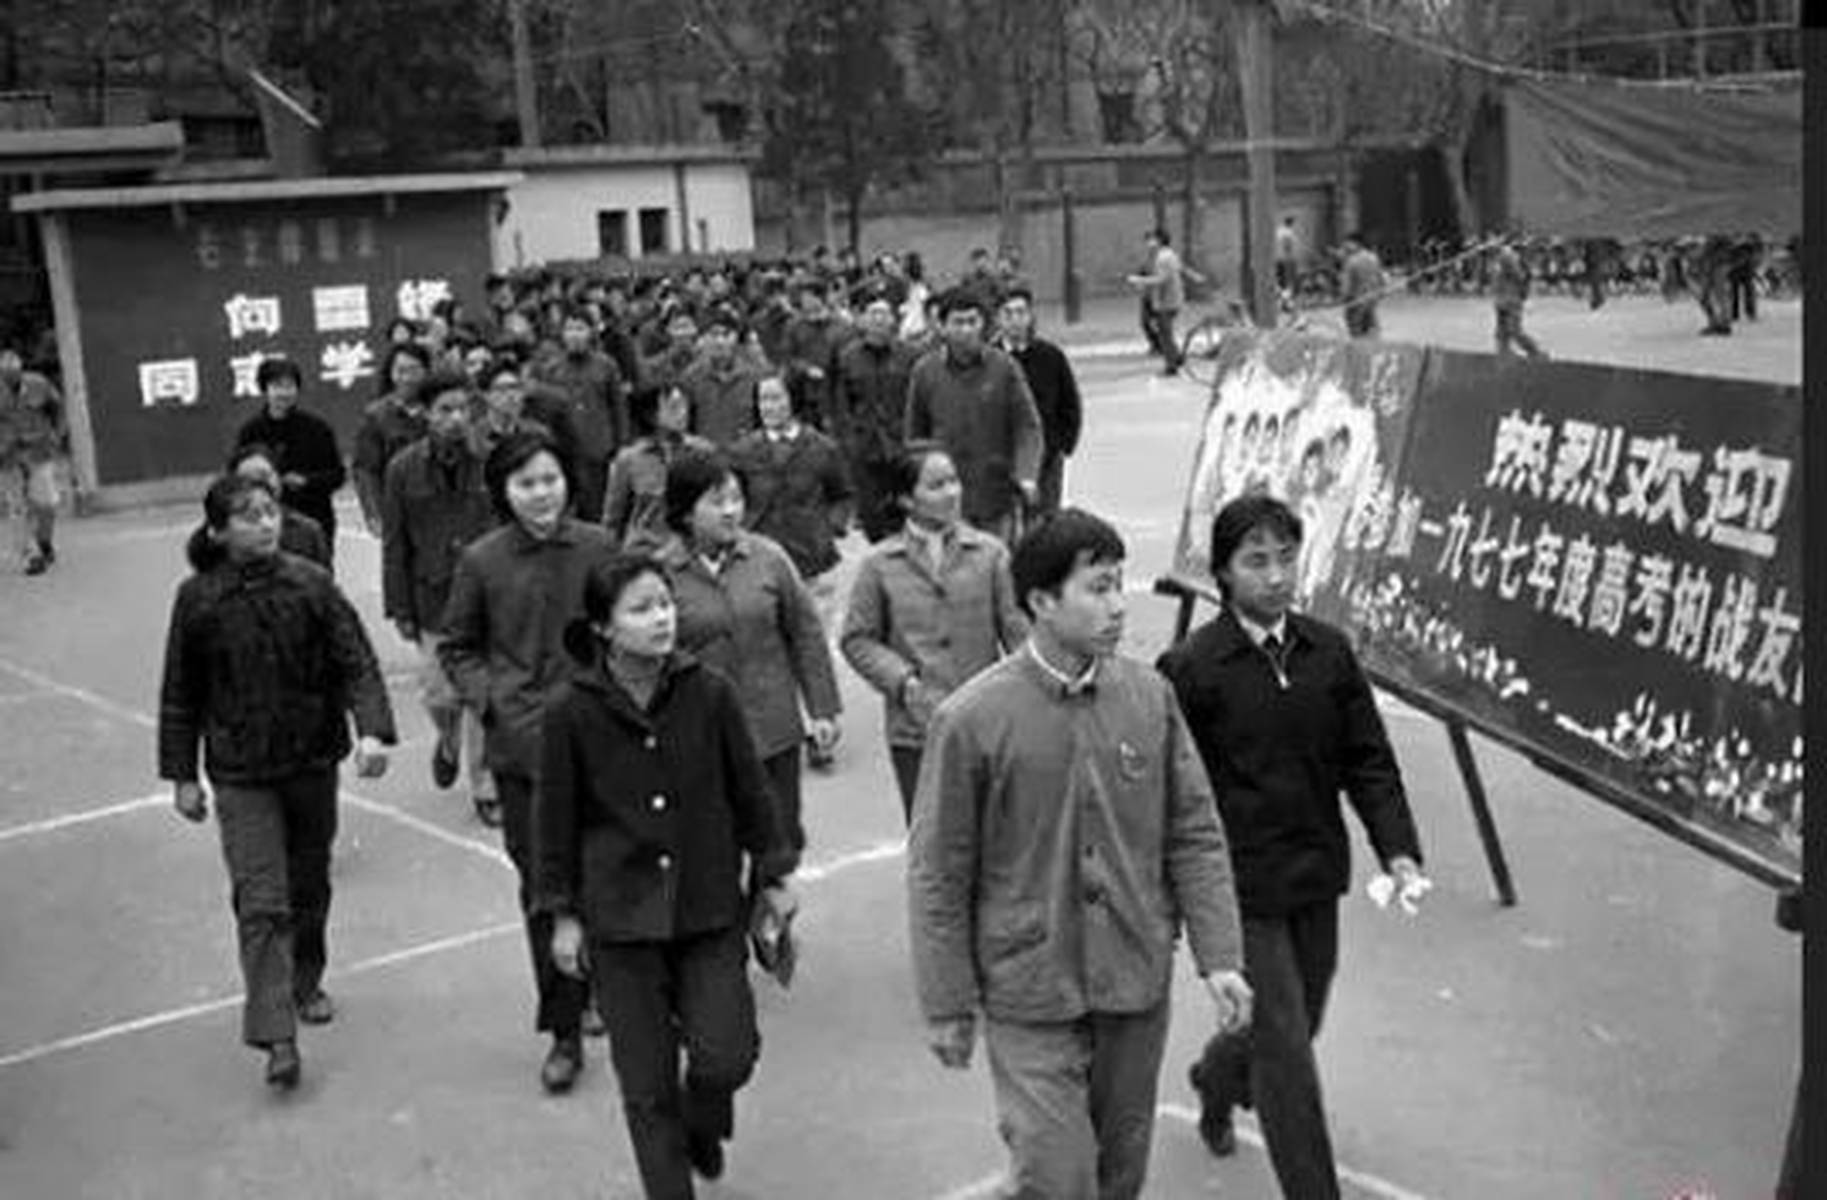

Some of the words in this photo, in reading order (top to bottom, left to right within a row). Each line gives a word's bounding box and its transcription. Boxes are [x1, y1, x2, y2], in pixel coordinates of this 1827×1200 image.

[1485, 408, 1792, 558] 热烈欢迎
[1345, 486, 1803, 705] 参加一九七七年度高考的战友
